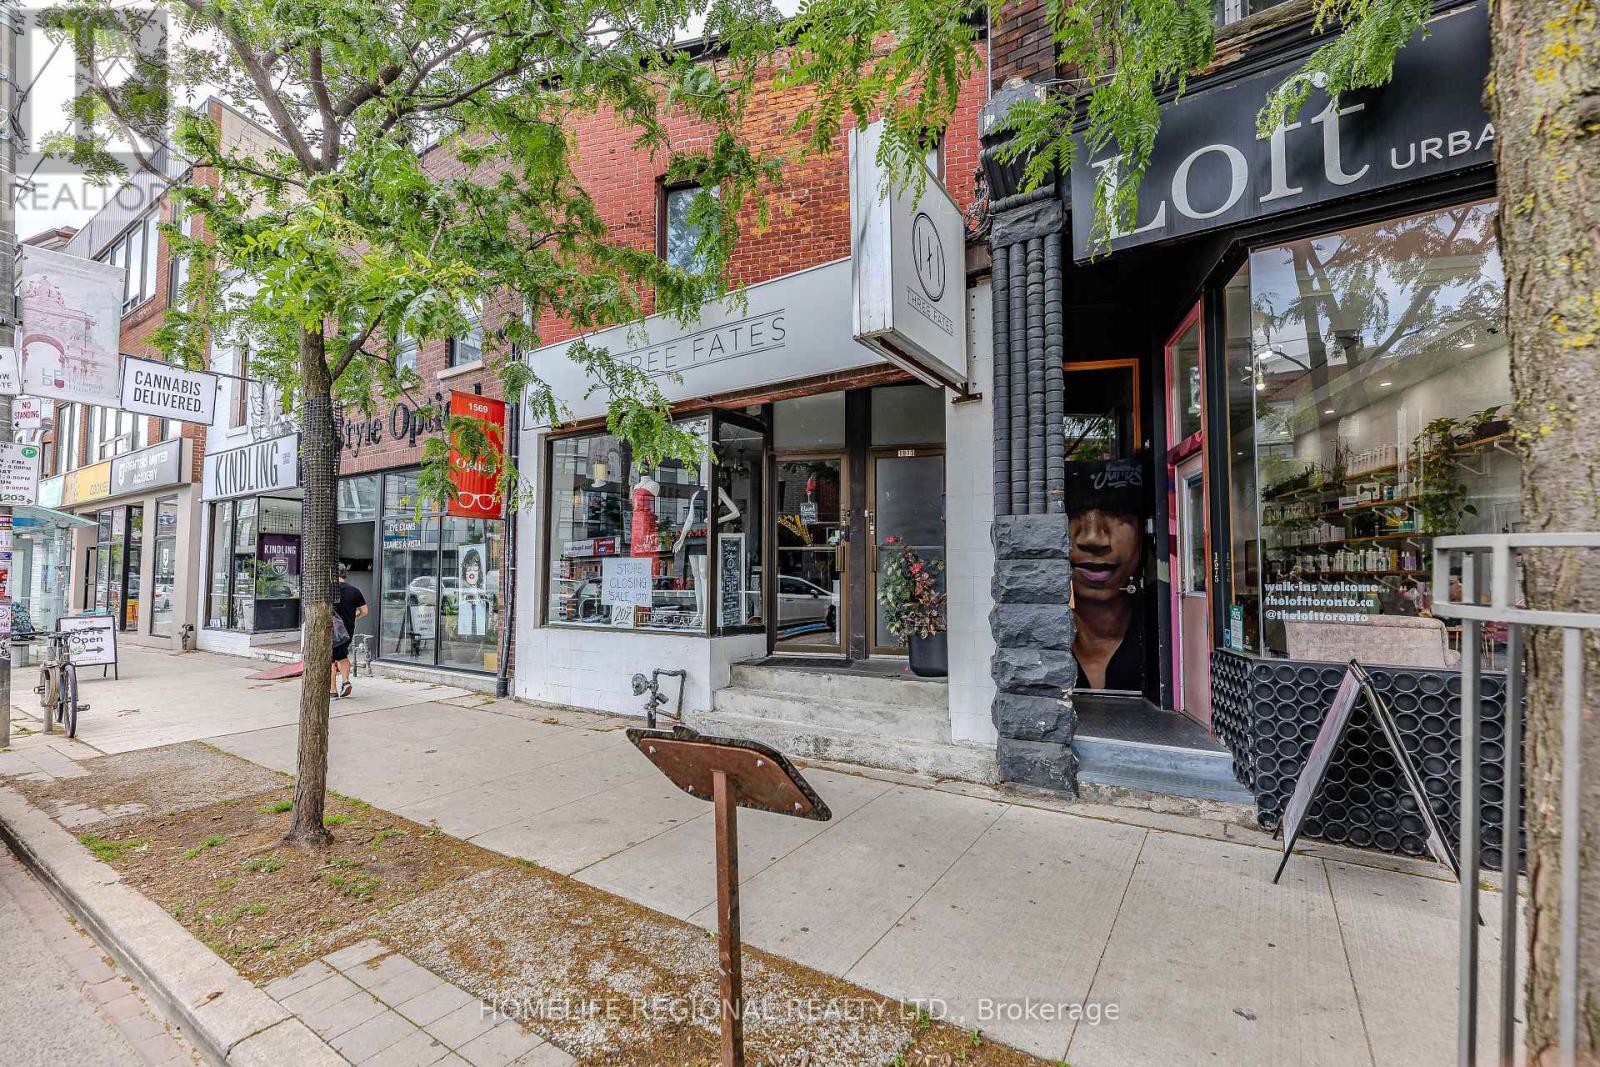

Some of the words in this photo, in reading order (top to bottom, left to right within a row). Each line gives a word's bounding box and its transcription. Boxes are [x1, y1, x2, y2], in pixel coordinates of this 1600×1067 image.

[1091, 72, 1370, 243] Loft
[907, 289, 931, 317] THREE
[934, 312, 954, 333] FATES
[693, 317, 786, 360] FATES
[135, 371, 201, 396] CANNABIS
[21, 401, 31, 409] NO
[133, 387, 204, 413] DELIVERED.
[468, 402, 488, 413] 1569
[14, 410, 39, 420] STANDING
[341, 406, 382, 457] tyle
[215, 441, 279, 496] KINDLING
[264, 544, 297, 555] KINDLING
[610, 577, 647, 590] CLOSING
[1264, 581, 1318, 596] walk-ins
[1264, 596, 1374, 607] thelofttoronto.ca
[614, 605, 632, 622] 20%
[638, 614, 668, 624] THREE
[1265, 609, 1369, 622] @thelofttoronto
[72, 636, 103, 645] Open
